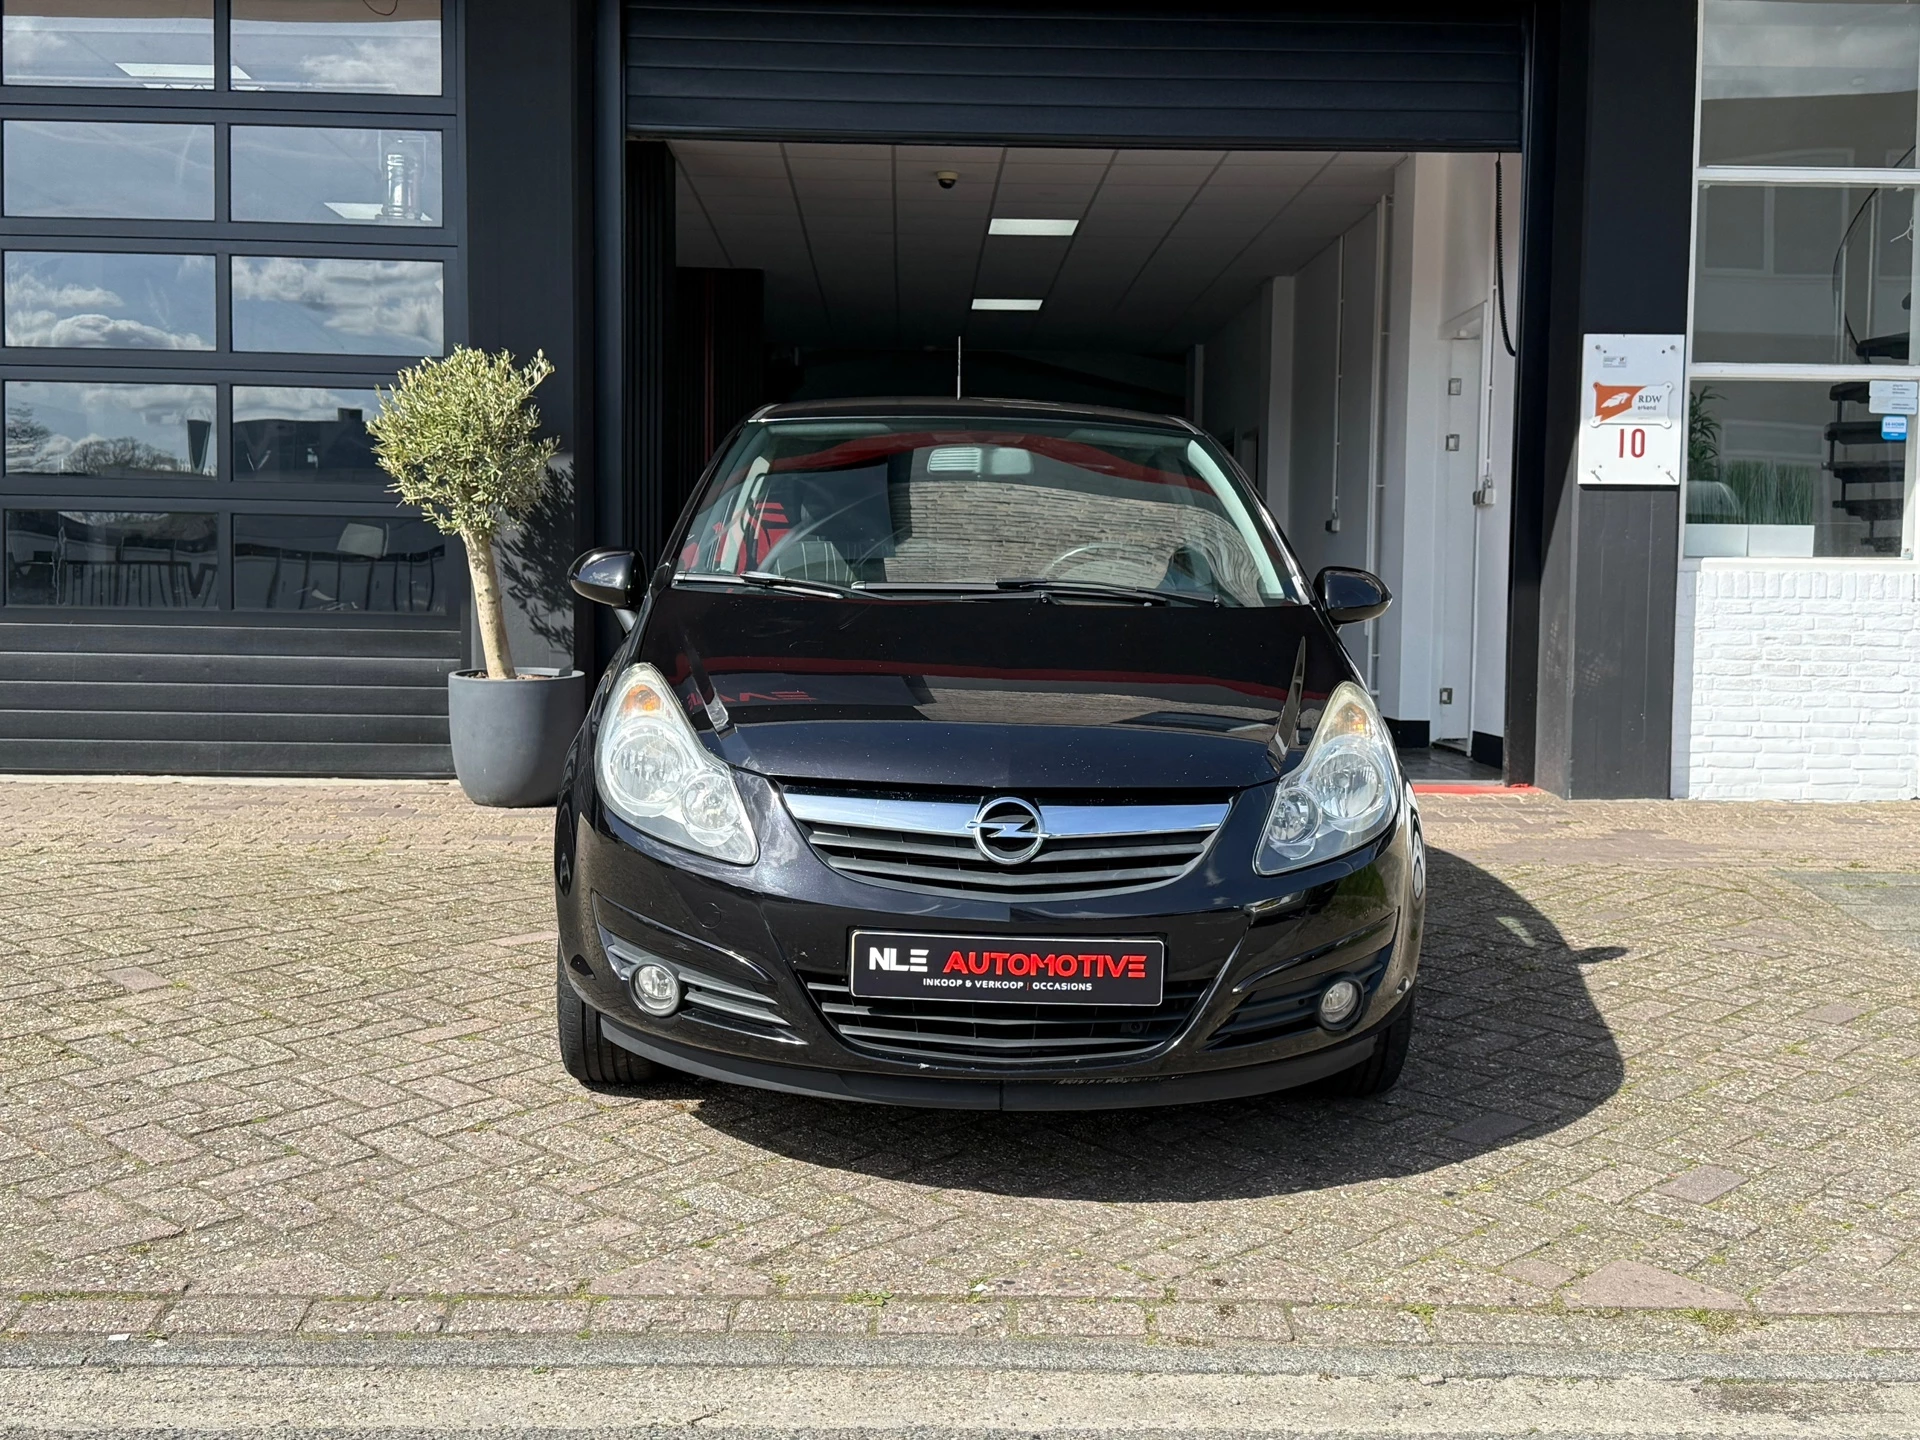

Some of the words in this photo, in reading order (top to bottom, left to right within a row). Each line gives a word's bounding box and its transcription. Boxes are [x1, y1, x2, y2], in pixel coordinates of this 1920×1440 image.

[1638, 395, 1662, 403] RDW
[1619, 428, 1646, 458] 10
[869, 947, 929, 972] NLE
[943, 951, 1147, 978] AUTOMOTIVE
[923, 978, 963, 988] INKOOP
[965, 979, 972, 988] &
[975, 980, 1024, 989] VERKOOP
[1032, 982, 1092, 991] OCCASIONS
